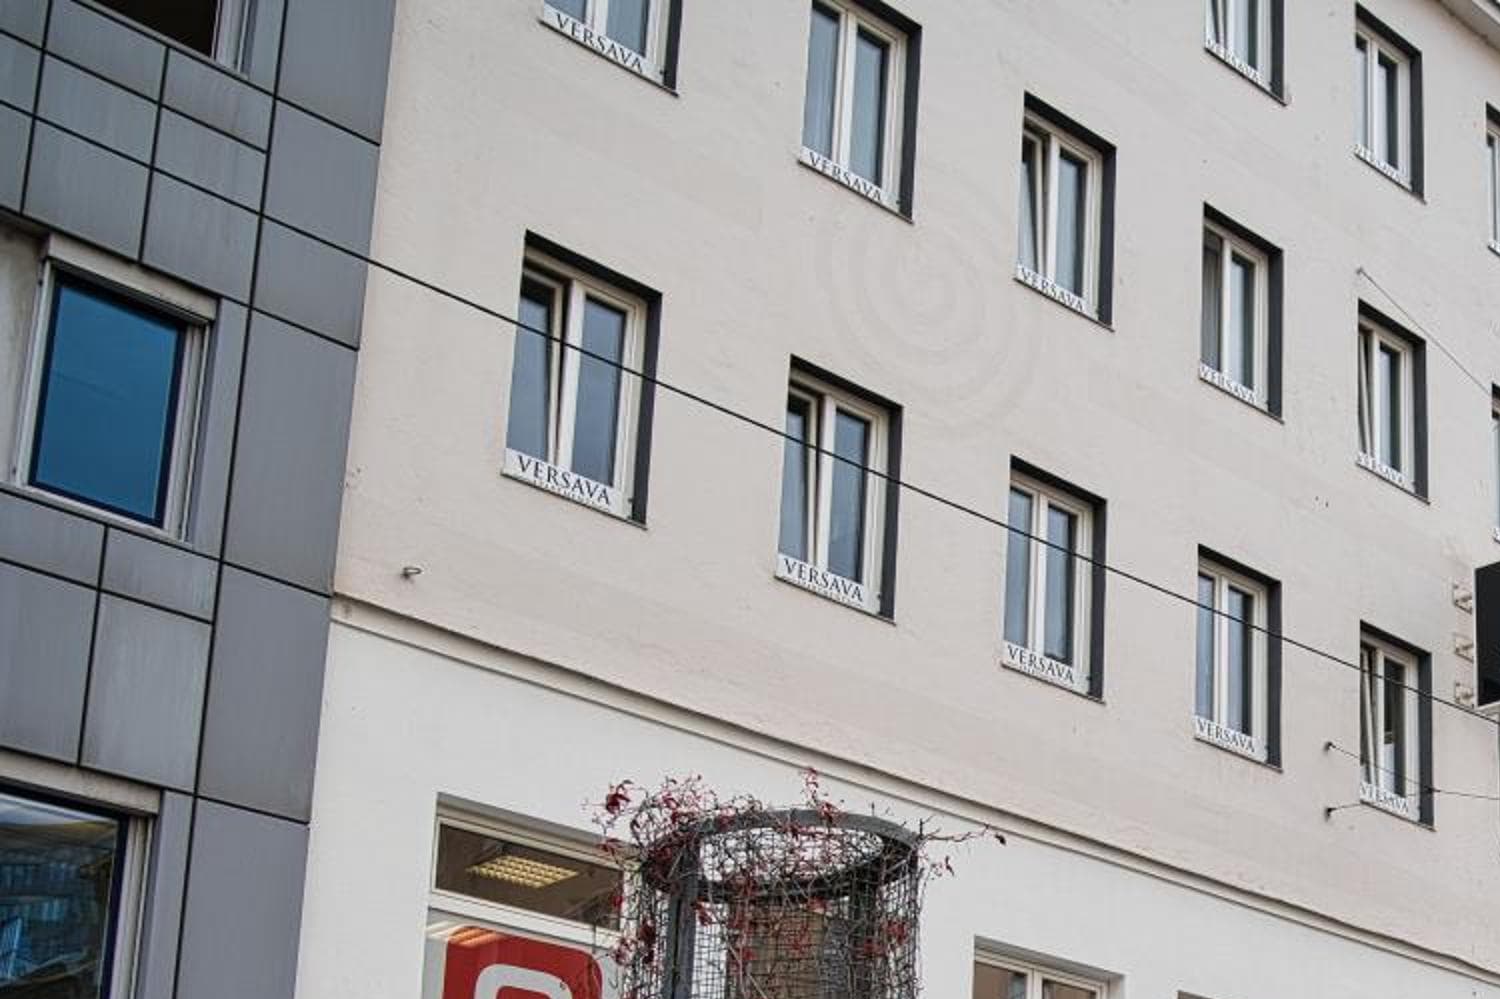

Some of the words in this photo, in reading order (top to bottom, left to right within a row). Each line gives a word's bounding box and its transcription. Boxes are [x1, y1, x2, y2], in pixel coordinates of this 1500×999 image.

[556, 13, 645, 73] VERSAVA
[809, 151, 883, 201] VERSAVA
[518, 455, 611, 505] VERSAVA
[785, 555, 864, 602] VERSAVA
[1008, 644, 1075, 684] VERSAVA
[1196, 717, 1256, 753] VERSAVA
